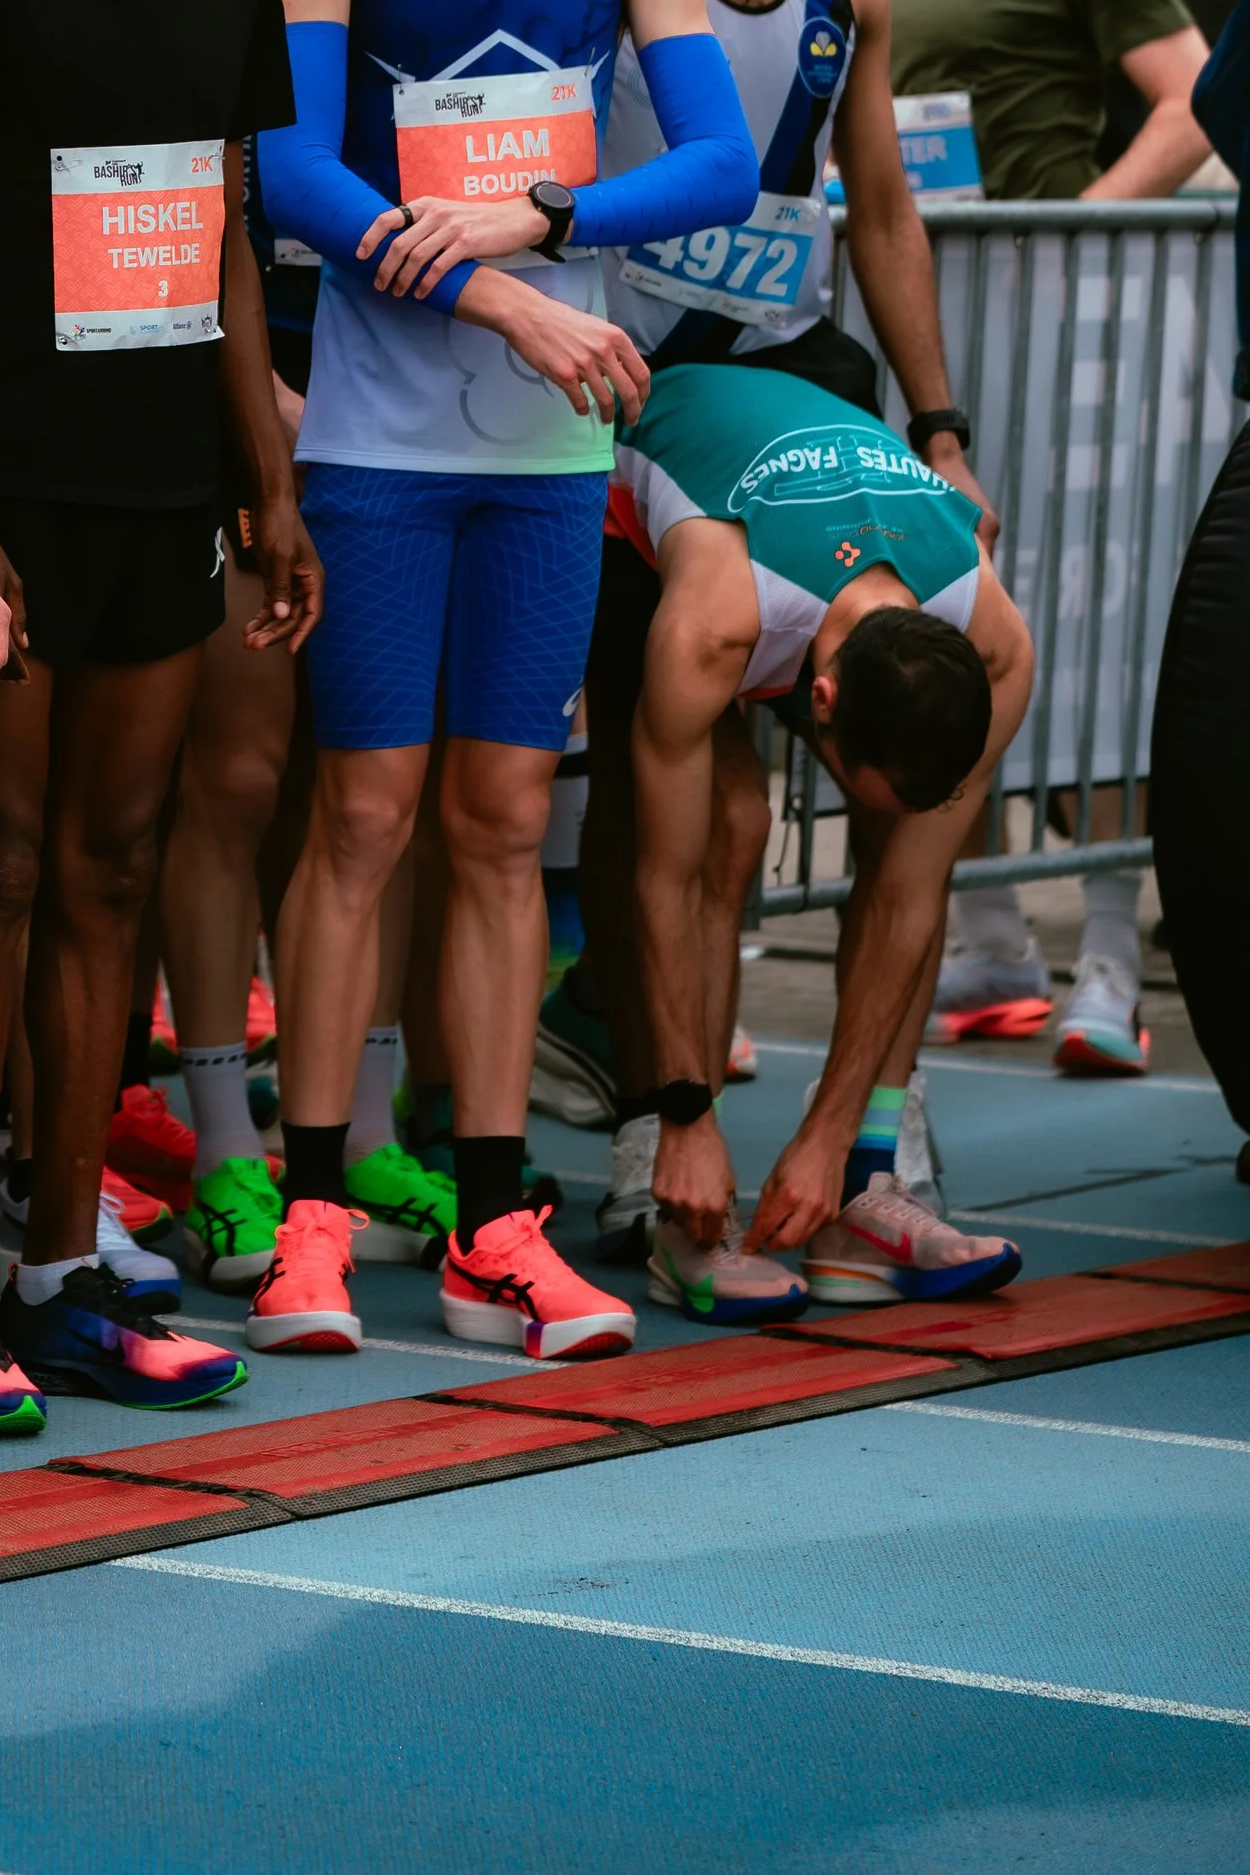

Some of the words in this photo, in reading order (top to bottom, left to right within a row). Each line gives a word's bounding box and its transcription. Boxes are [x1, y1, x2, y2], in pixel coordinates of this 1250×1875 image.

[551, 83, 578, 101] 21K
[465, 128, 550, 164] LIAM
[94, 162, 137, 179] BASHIR'S
[191, 156, 213, 174] 21K
[102, 201, 204, 236] HISKEL
[775, 206, 802, 222] 21K
[108, 242, 200, 269] TEWELDE
[642, 226, 798, 297] 4972
[158, 279, 168, 298] 3
[740, 446, 839, 494] FAGNES
